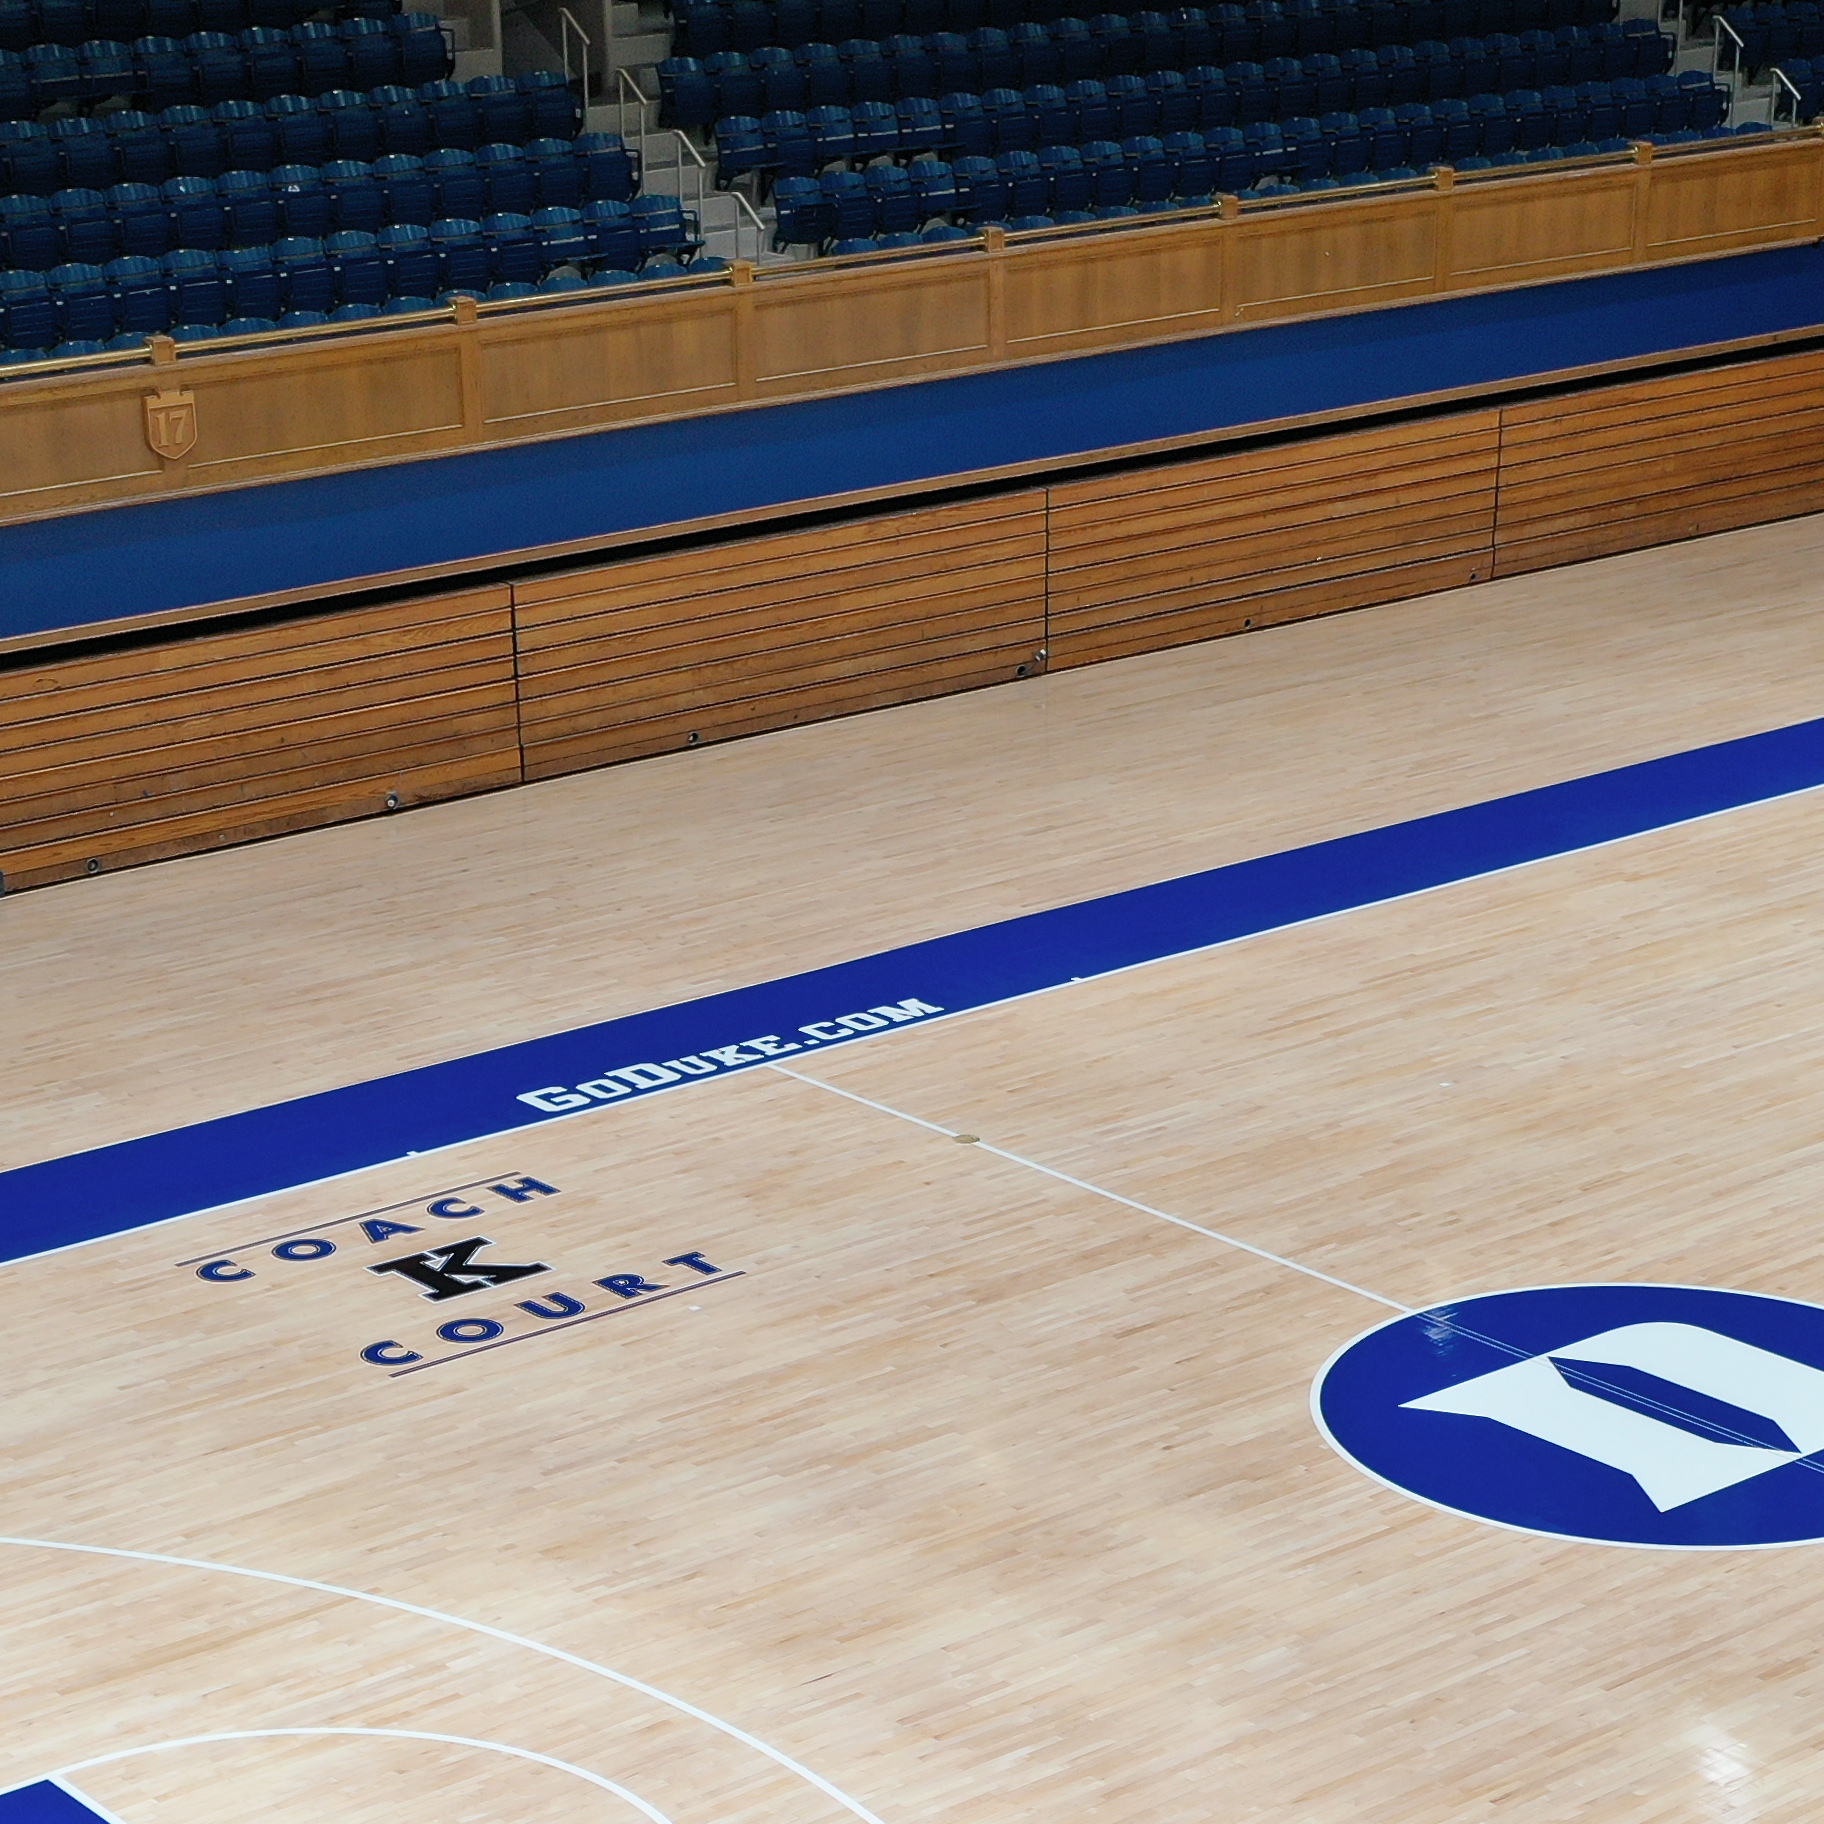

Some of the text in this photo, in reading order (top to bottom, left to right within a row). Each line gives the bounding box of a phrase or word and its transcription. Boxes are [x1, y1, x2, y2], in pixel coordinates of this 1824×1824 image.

[156, 409, 188, 447] 17
[195, 1176, 562, 1284] COACH
[364, 1236, 555, 1304] K
[359, 1250, 724, 1368] COURT
